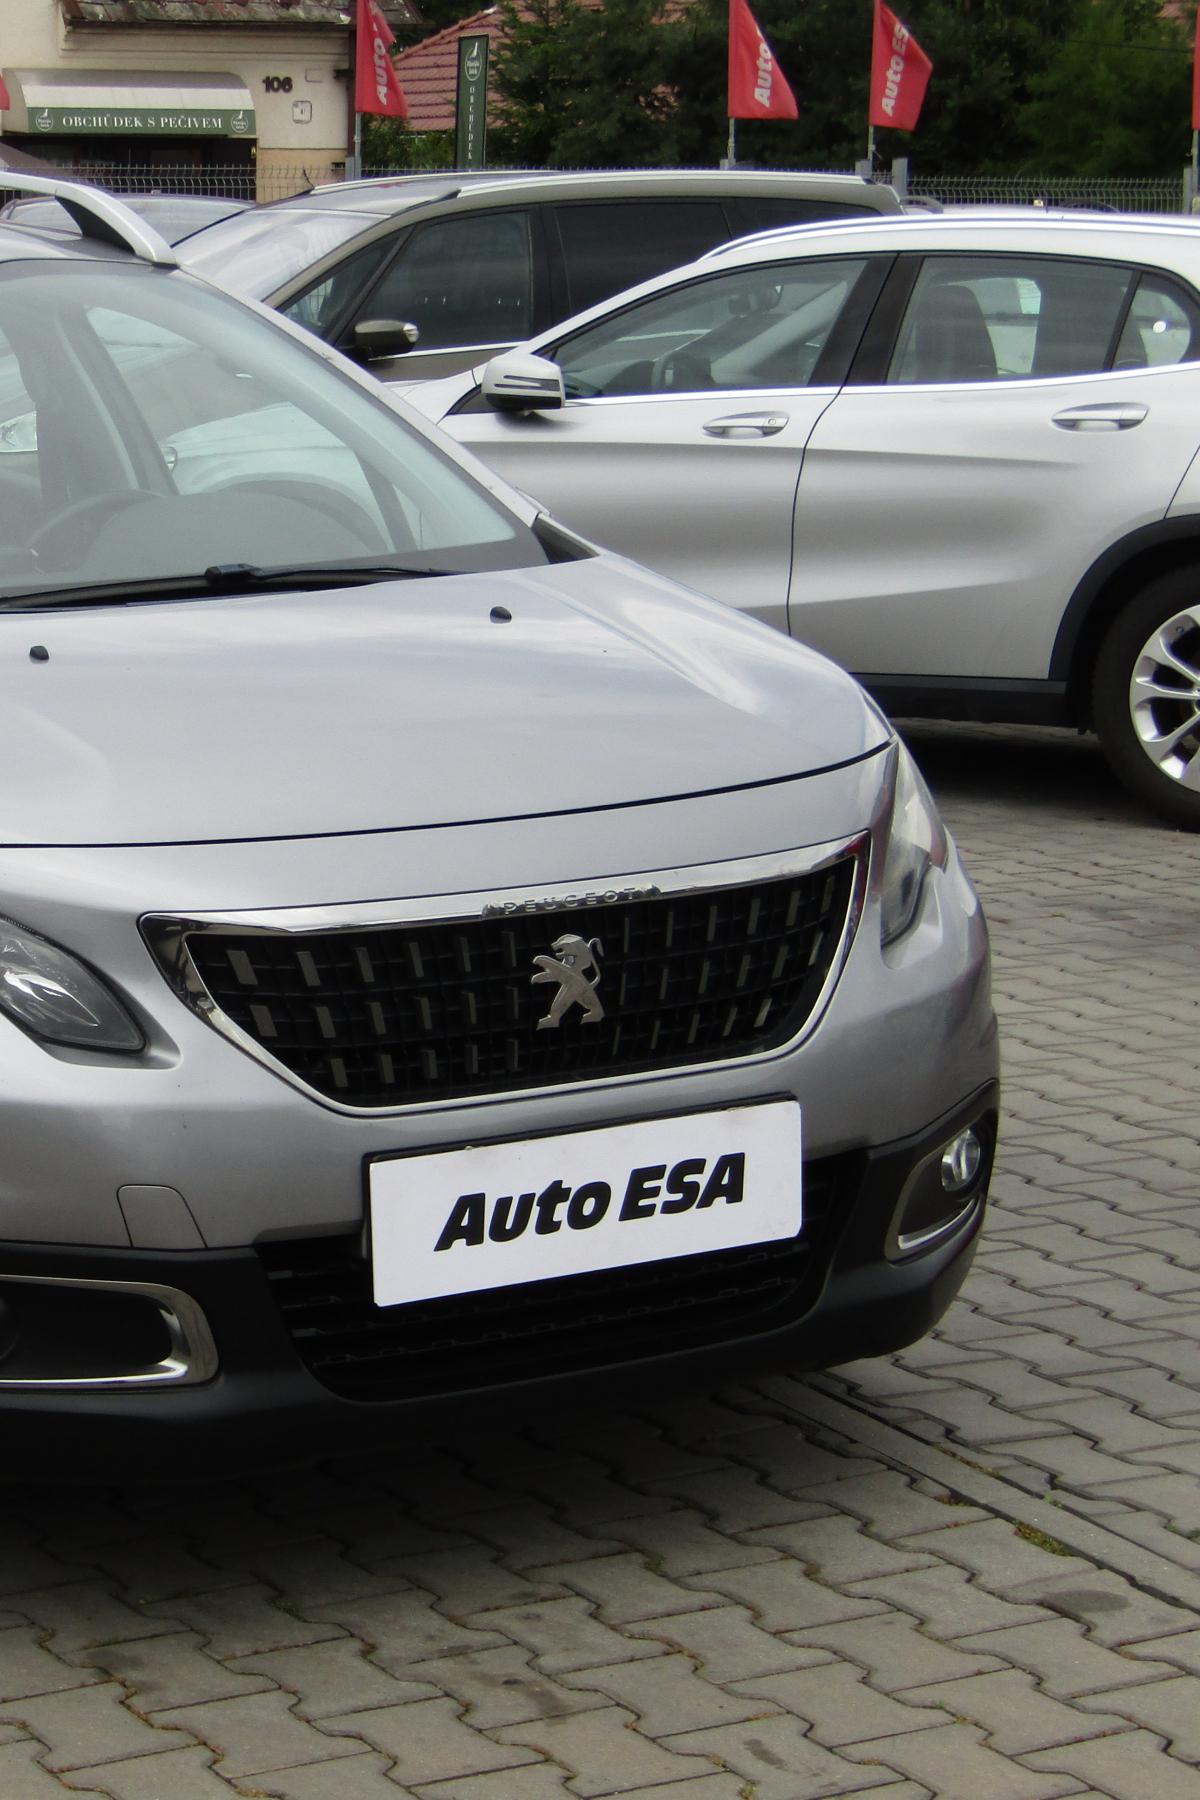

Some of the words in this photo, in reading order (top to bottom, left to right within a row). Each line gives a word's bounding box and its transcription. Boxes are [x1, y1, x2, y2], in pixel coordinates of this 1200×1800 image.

[374, 38, 387, 105] Auto
[754, 43, 773, 108] Auto
[882, 55, 904, 117] Auto
[62, 113, 143, 128] OBCHŮDEK
[147, 115, 156, 128] S
[160, 114, 224, 129] PEČIVEM
[504, 887, 636, 914] PEUGEOT
[434, 1180, 612, 1252] Auto
[618, 1152, 746, 1222] ESA
